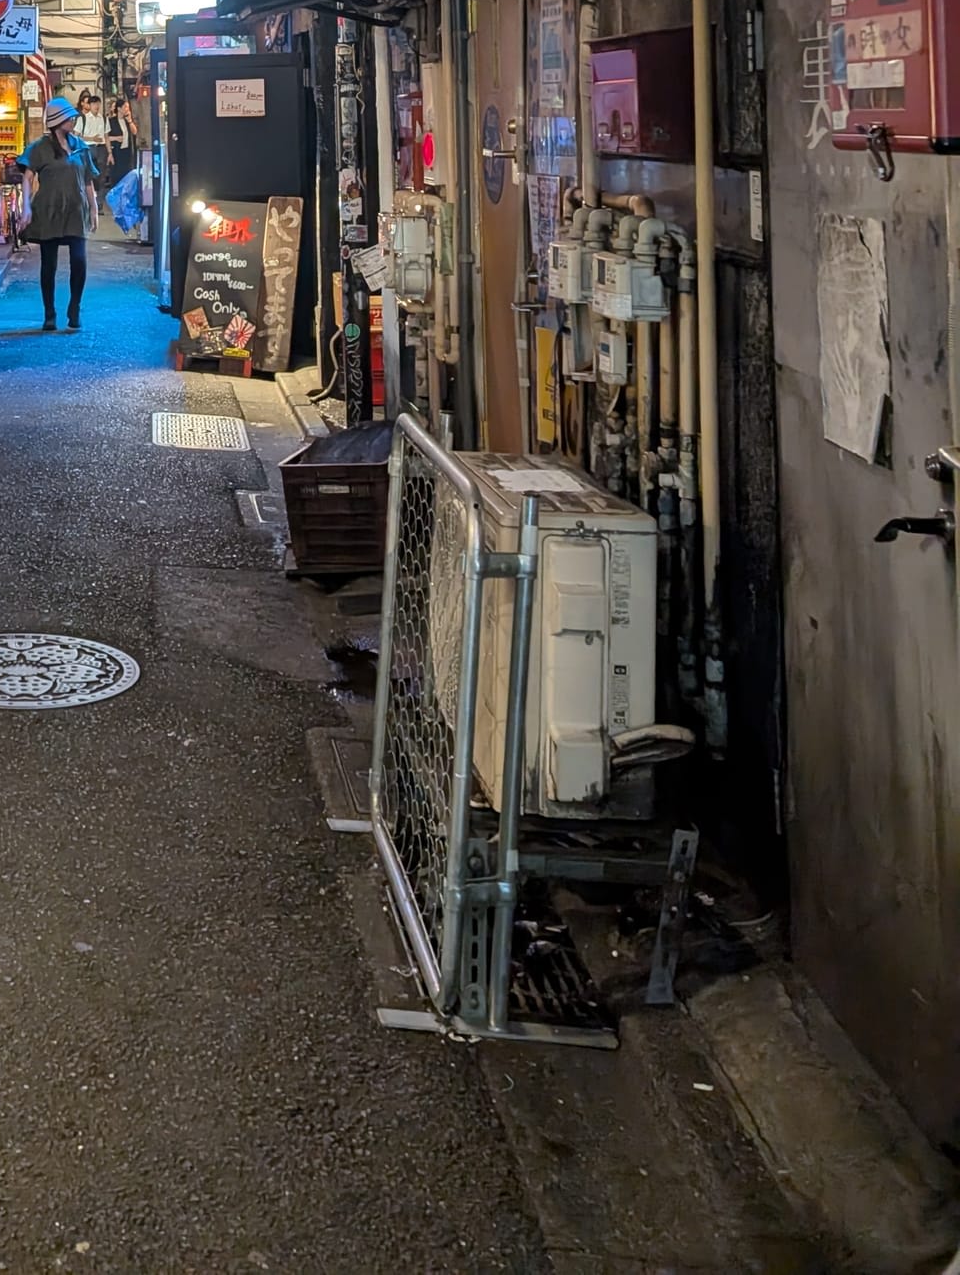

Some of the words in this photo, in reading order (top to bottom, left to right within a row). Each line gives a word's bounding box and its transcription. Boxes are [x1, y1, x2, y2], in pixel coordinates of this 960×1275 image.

[194, 252, 232, 264] Charge
[257, 205, 301, 365] やってます
[194, 287, 220, 302] Cash
